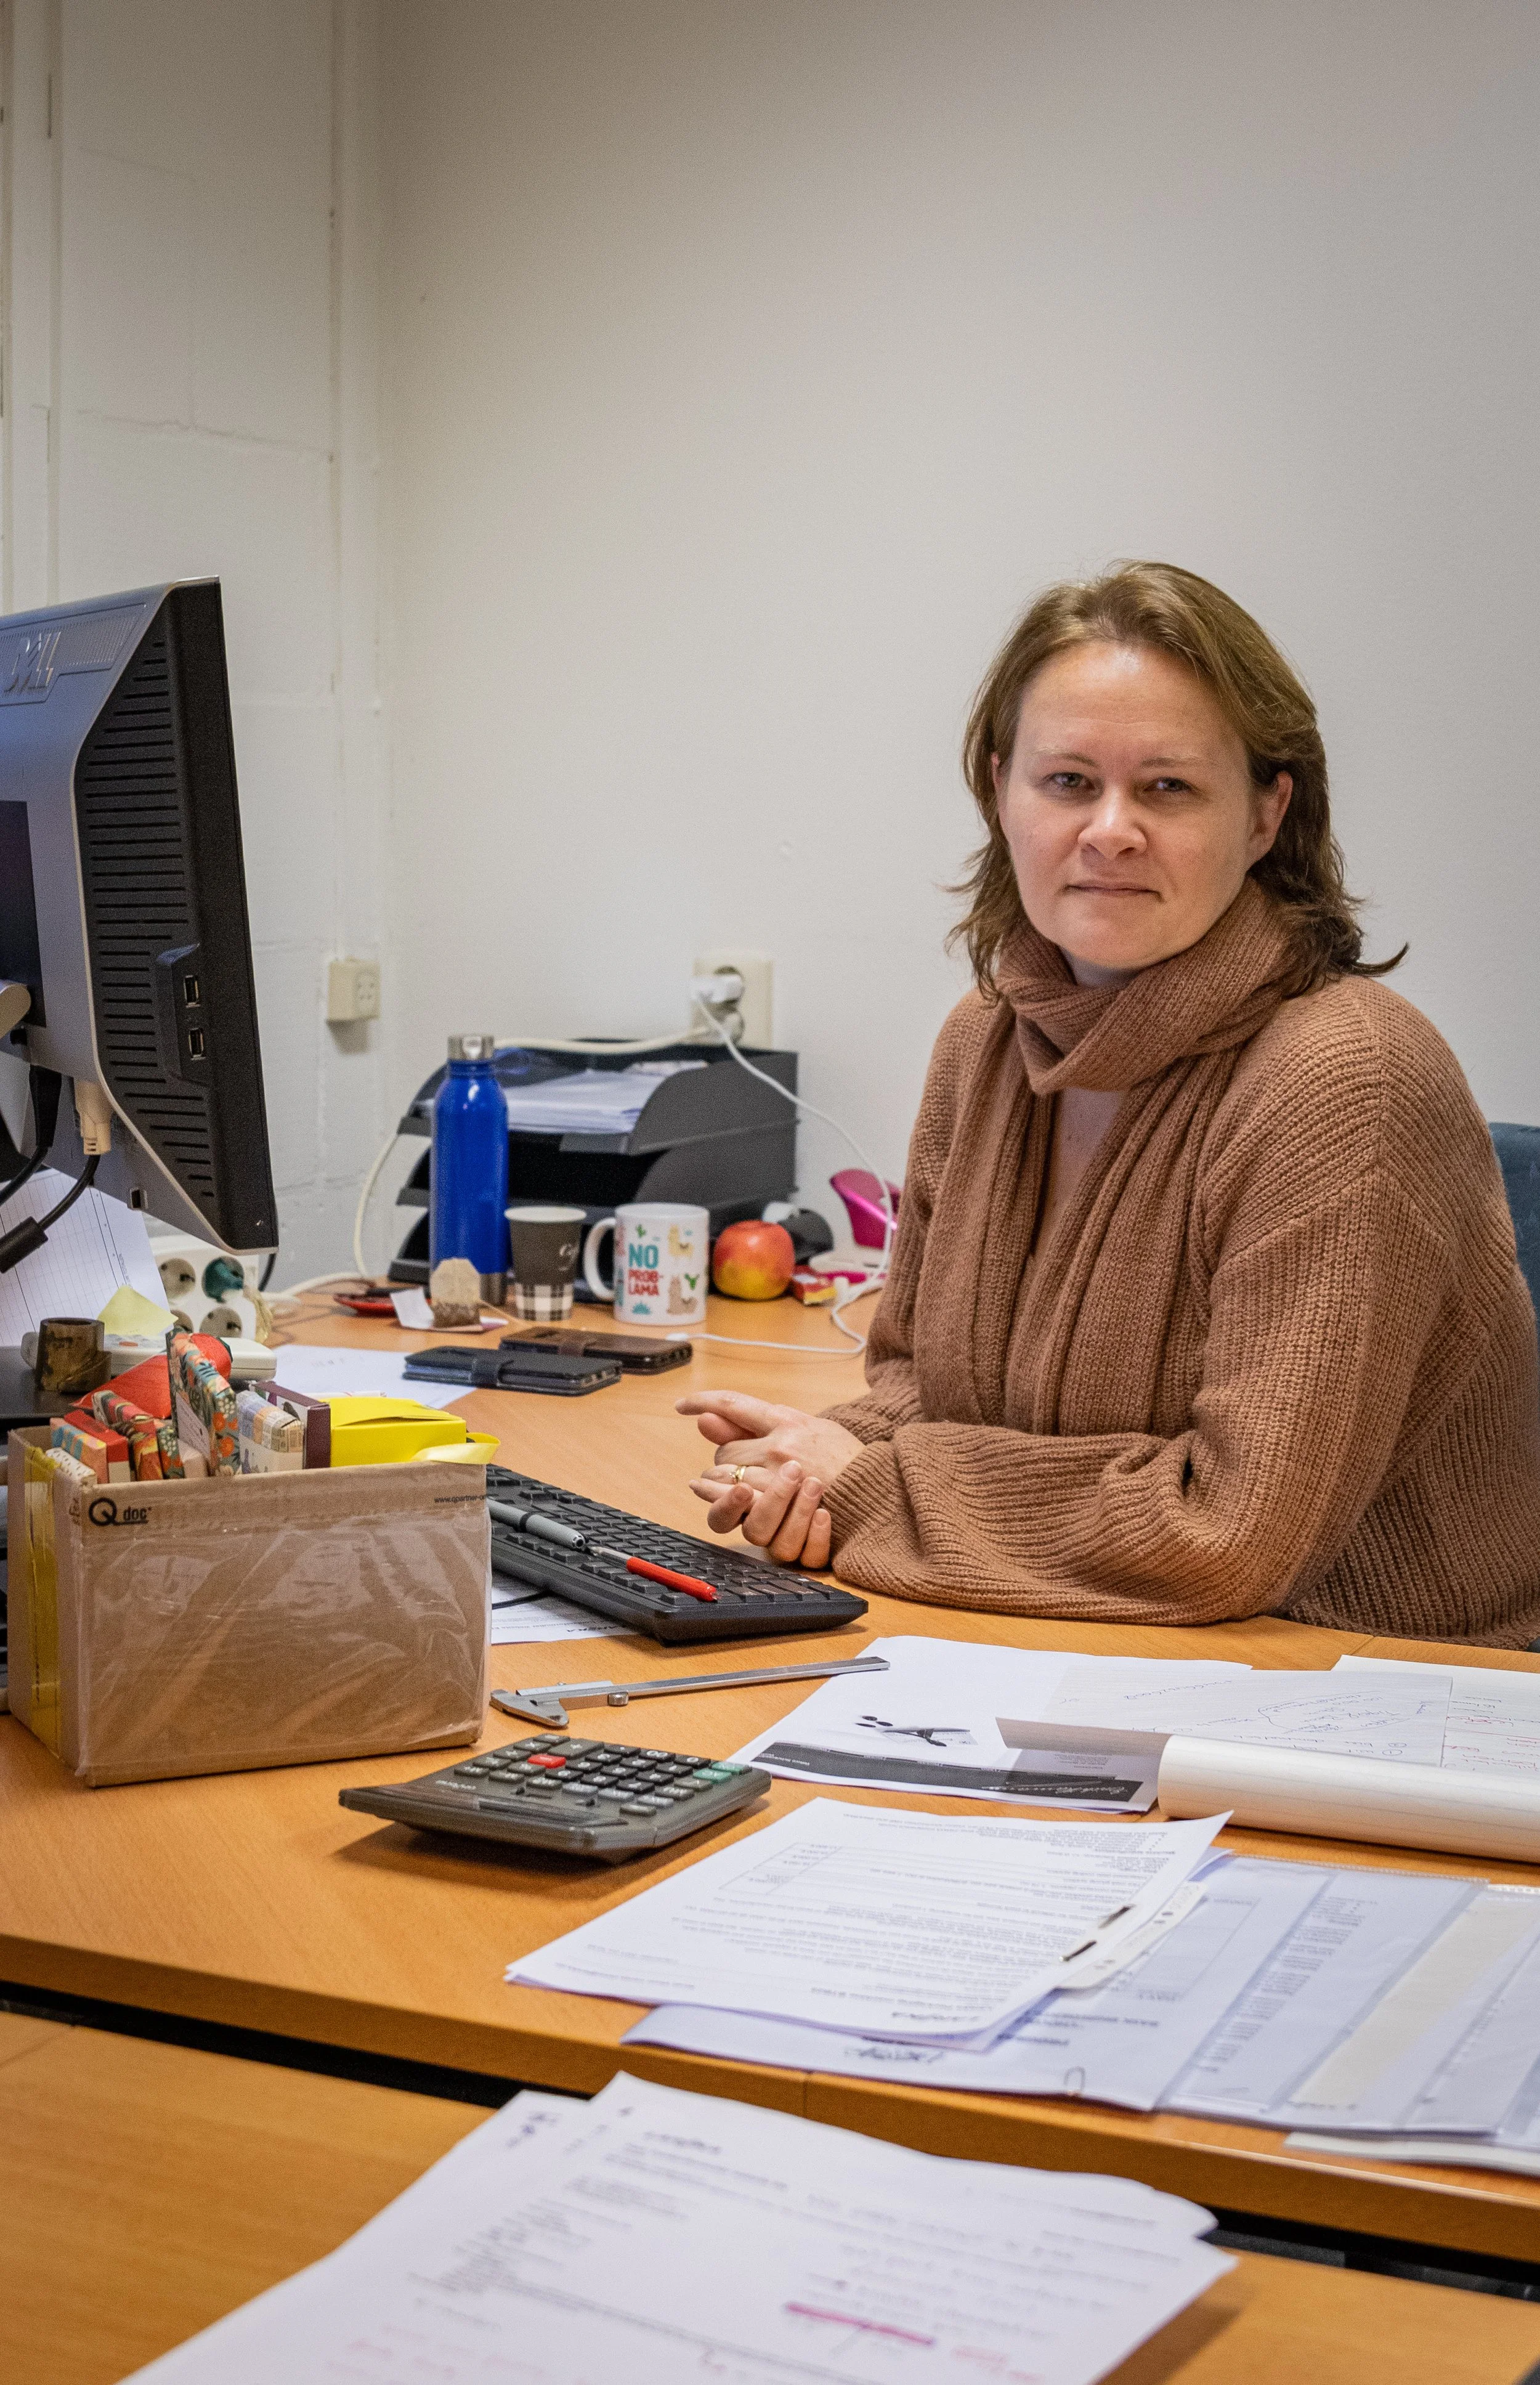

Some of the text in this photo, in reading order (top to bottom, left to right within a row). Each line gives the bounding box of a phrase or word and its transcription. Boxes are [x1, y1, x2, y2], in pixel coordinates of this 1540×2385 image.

[628, 1243, 659, 1269] NO
[628, 1283, 659, 1296] LAMA
[89, 1497, 118, 1526] Q
